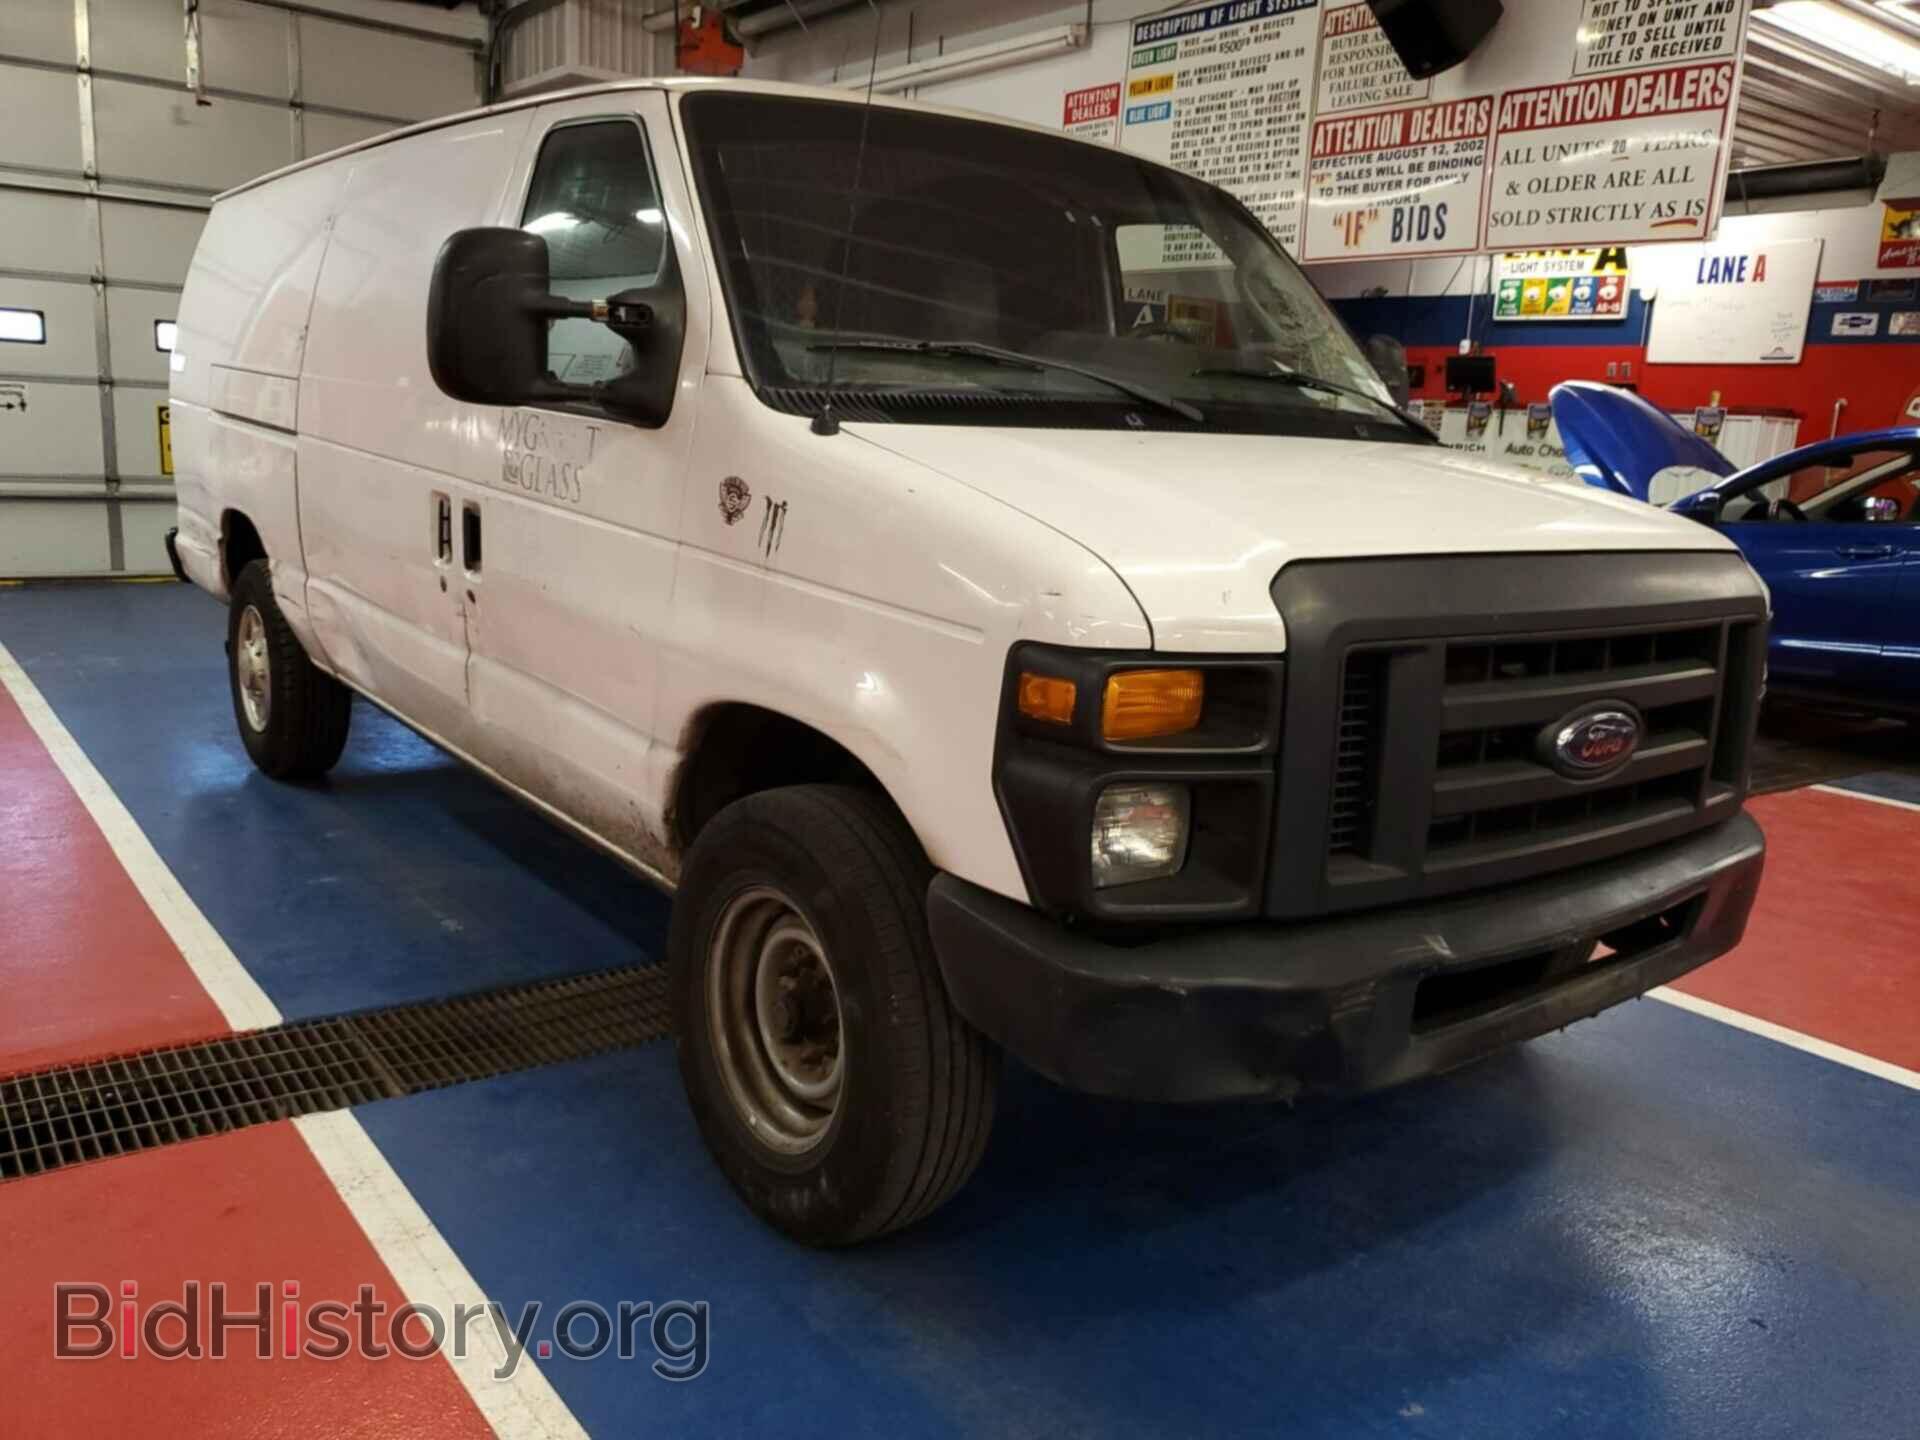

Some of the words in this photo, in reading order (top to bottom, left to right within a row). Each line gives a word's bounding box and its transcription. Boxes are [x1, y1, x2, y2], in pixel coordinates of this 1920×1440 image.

[1136, 12, 1206, 42] DESCRIPTION
[1210, 8, 1224, 25] OF
[1228, 1, 1261, 20] LIGHT
[1324, 3, 1377, 37] ATTENTIO
[1592, 1, 1618, 18] NOT
[1625, 0, 1640, 12] TO
[1638, 11, 1657, 27] ON
[1664, 4, 1698, 23] UNIT
[1704, 1, 1735, 16] AND
[1331, 32, 1369, 51] BUYER
[1621, 31, 1637, 46] TO
[1643, 24, 1676, 43] SELL
[1684, 18, 1727, 37] UNTIL
[1329, 43, 1393, 66] RESPONSIB
[1588, 50, 1621, 68] TITLE
[1629, 47, 1643, 62] IS
[1650, 36, 1723, 59] RECEIVED
[1323, 67, 1345, 80] FOR
[1349, 58, 1401, 76] MECHAN
[1067, 86, 1119, 108] ATTENTION
[1329, 75, 1376, 94] FAILURE
[1331, 89, 1381, 108] LEAVING
[1385, 84, 1414, 98] SALE
[1072, 100, 1112, 122] DEALERS
[1498, 79, 1617, 132] ATTENTION
[1620, 64, 1732, 117] DEALERS
[1313, 112, 1405, 156] ATTENTION
[1409, 100, 1491, 143] DEALERS
[1312, 155, 1372, 170] EFFECTIVE
[1377, 147, 1426, 162] AUGUST
[1432, 145, 1449, 157] 12,
[1453, 139, 1484, 153] 2002
[1500, 147, 1536, 166] ALL
[1336, 167, 1372, 182] SALES
[1376, 164, 1404, 178] WILL
[1408, 161, 1424, 174] BE
[1428, 155, 1483, 171] BINDING
[1505, 179, 1521, 197] &
[1527, 173, 1597, 195] OLDER
[1603, 168, 1647, 190] ARE
[1651, 164, 1695, 185] ALL
[1319, 185, 1334, 197] TO
[1337, 183, 1358, 196] THE
[1363, 180, 1403, 193] BUYER
[1406, 176, 1434, 188] FOR
[1332, 209, 1379, 247] "IF"
[1391, 202, 1448, 243] BIDS
[1489, 209, 1541, 228] SOLD
[1545, 201, 1648, 225] STRICTLY
[1649, 200, 1678, 220] AS
[1684, 197, 1706, 216] IS
[1510, 262, 1539, 274] LIGHT
[1545, 260, 1586, 273] SYSTEM
[1697, 255, 1748, 285] LANE
[1752, 253, 1767, 283] A
[1504, 442, 1534, 456] Auto
[519, 453, 584, 504] GLASS
